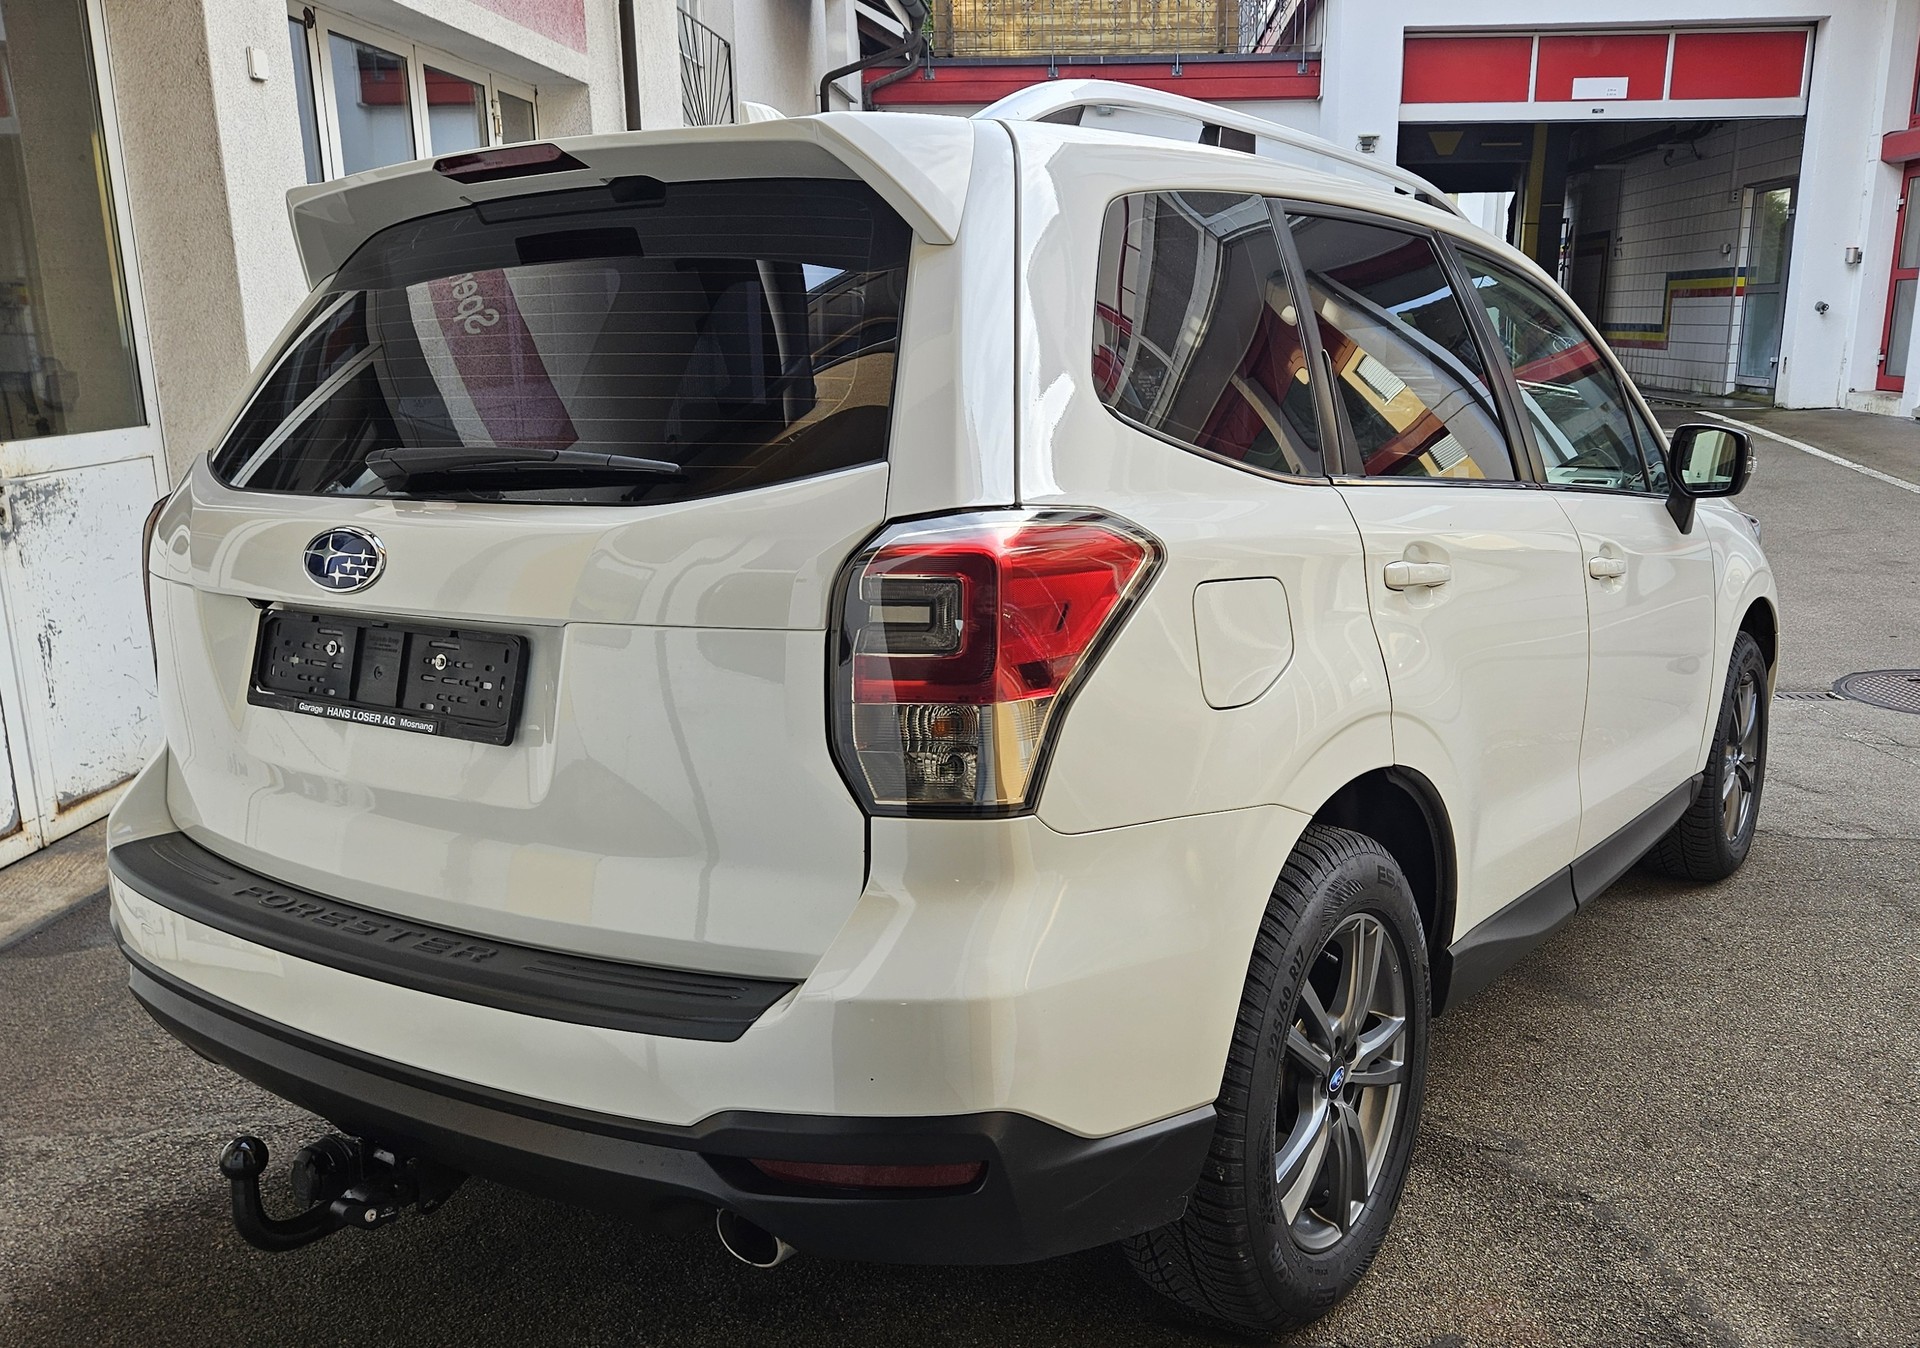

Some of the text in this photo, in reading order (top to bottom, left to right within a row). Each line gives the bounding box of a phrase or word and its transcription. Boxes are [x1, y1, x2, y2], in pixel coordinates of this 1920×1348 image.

[299, 702, 434, 732] Garage HANS LOSER AG Mosnang
[231, 886, 498, 963] FORESTER
[1288, 944, 1304, 982] R17
